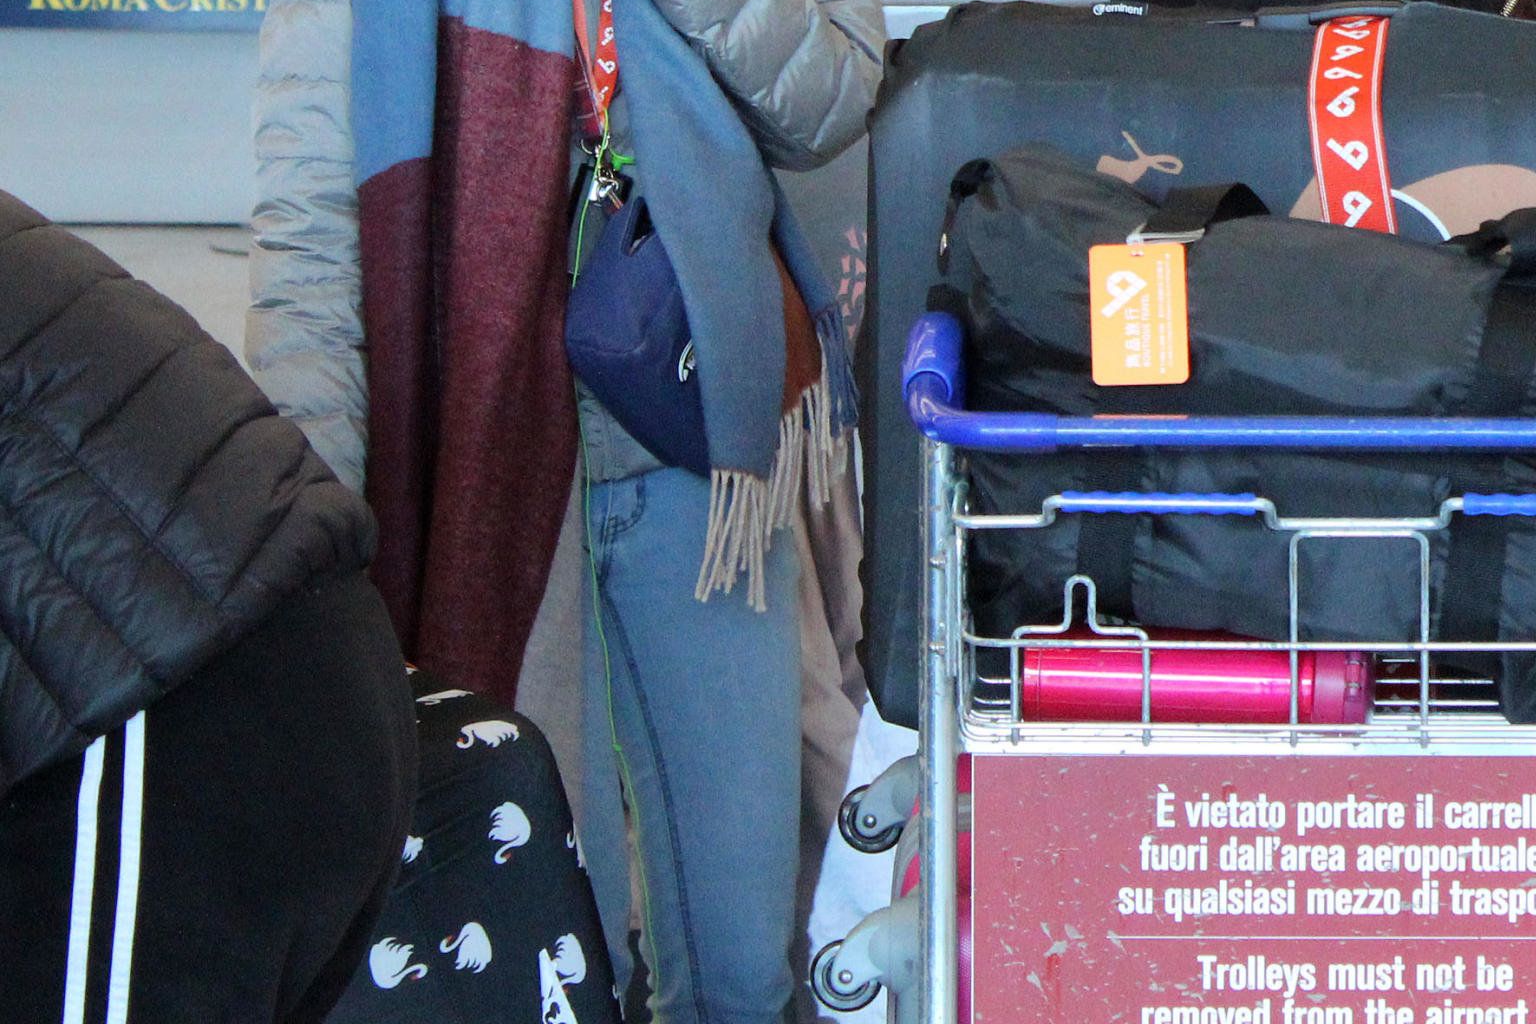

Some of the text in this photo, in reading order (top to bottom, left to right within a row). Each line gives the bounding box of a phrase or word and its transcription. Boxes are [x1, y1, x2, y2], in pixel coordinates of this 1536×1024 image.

[1156, 783, 1176, 828] È
[1184, 792, 1286, 828] vietato
[1297, 793, 1405, 836] portare
[1416, 793, 1434, 829] il
[1139, 835, 1208, 872] fuori
[1118, 886, 1154, 916] su
[1164, 879, 1296, 923] qualsiasi
[1306, 887, 1401, 916] mezzo
[1412, 880, 1439, 916] di
[1197, 955, 1514, 998] Trolleys must not be
[1141, 998, 1271, 1024] removed
[1282, 998, 1353, 1024] from
[1364, 998, 1415, 1024] the
